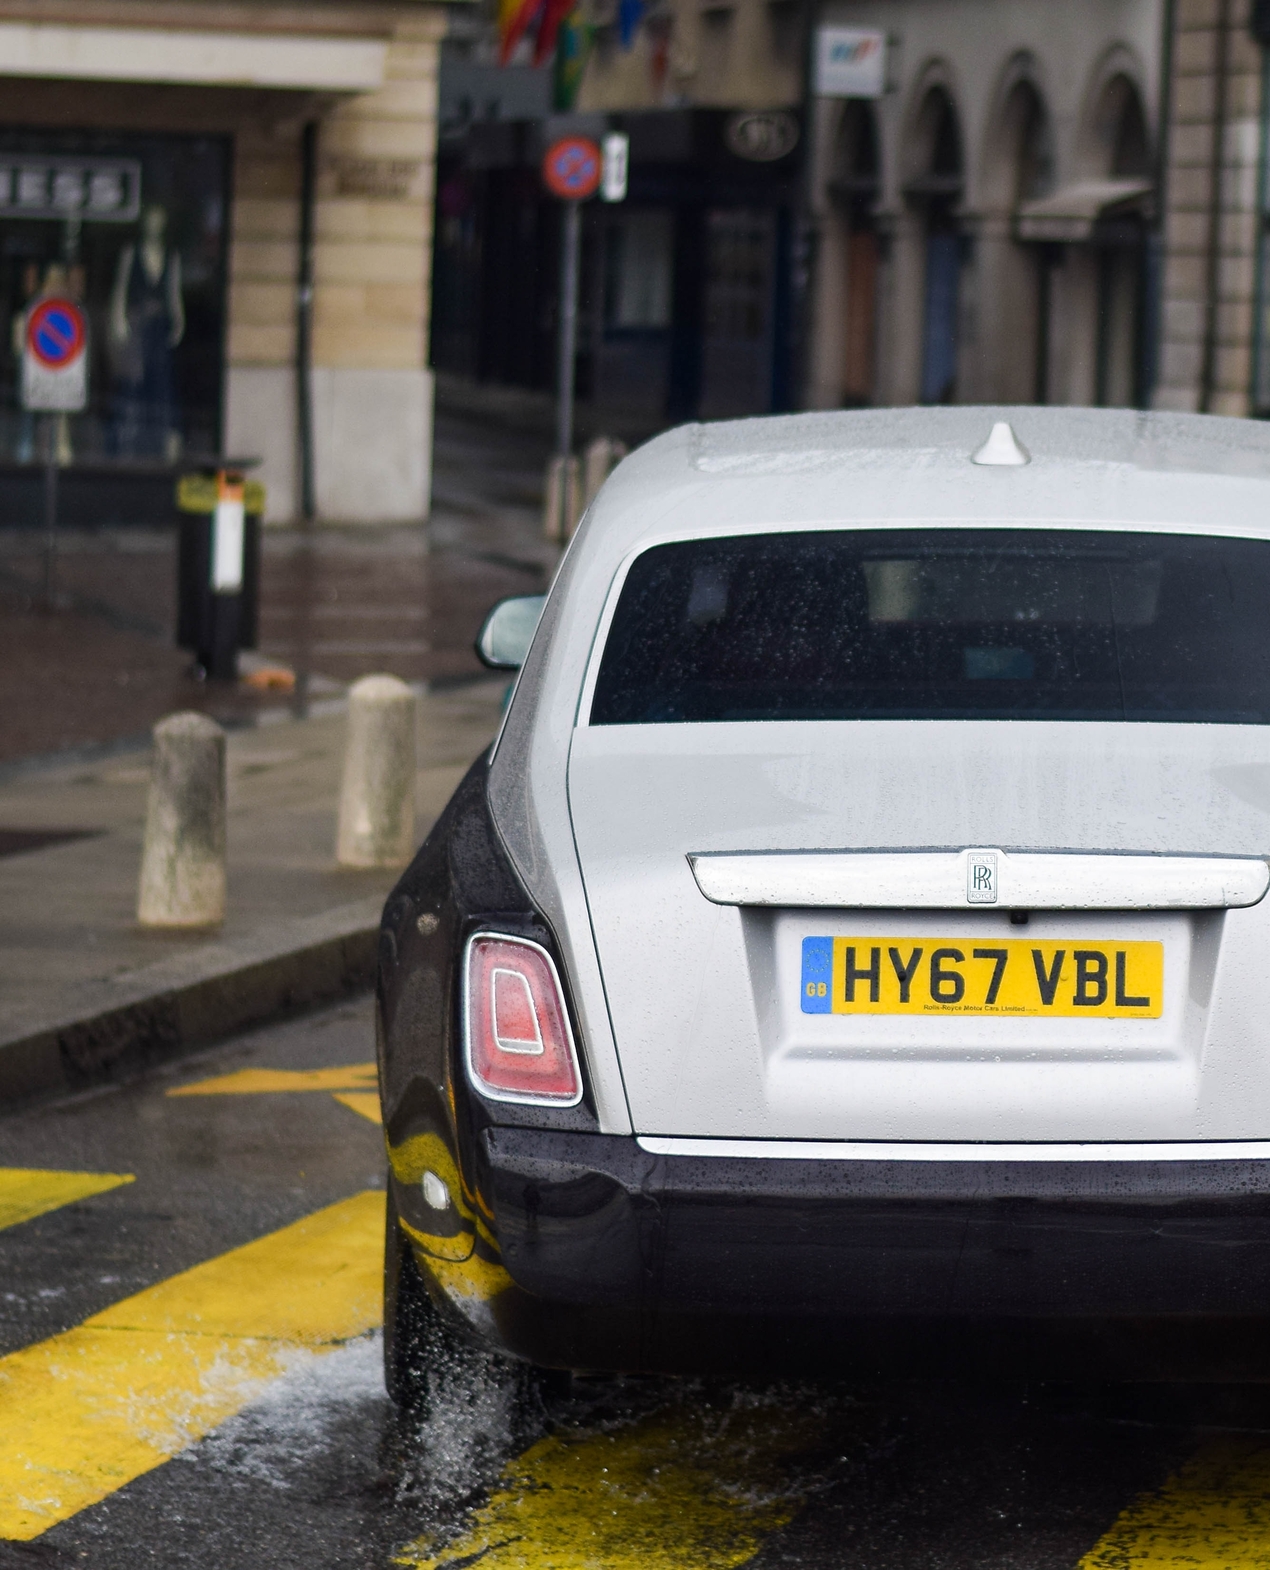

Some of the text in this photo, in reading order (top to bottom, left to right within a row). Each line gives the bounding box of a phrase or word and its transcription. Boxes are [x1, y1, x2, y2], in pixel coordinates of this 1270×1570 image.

[971, 892, 994, 900] ROYCE
[844, 946, 1150, 1007] HY67 VBL
[806, 982, 828, 998] GB
[923, 1004, 961, 1012] Rolls-Royce
